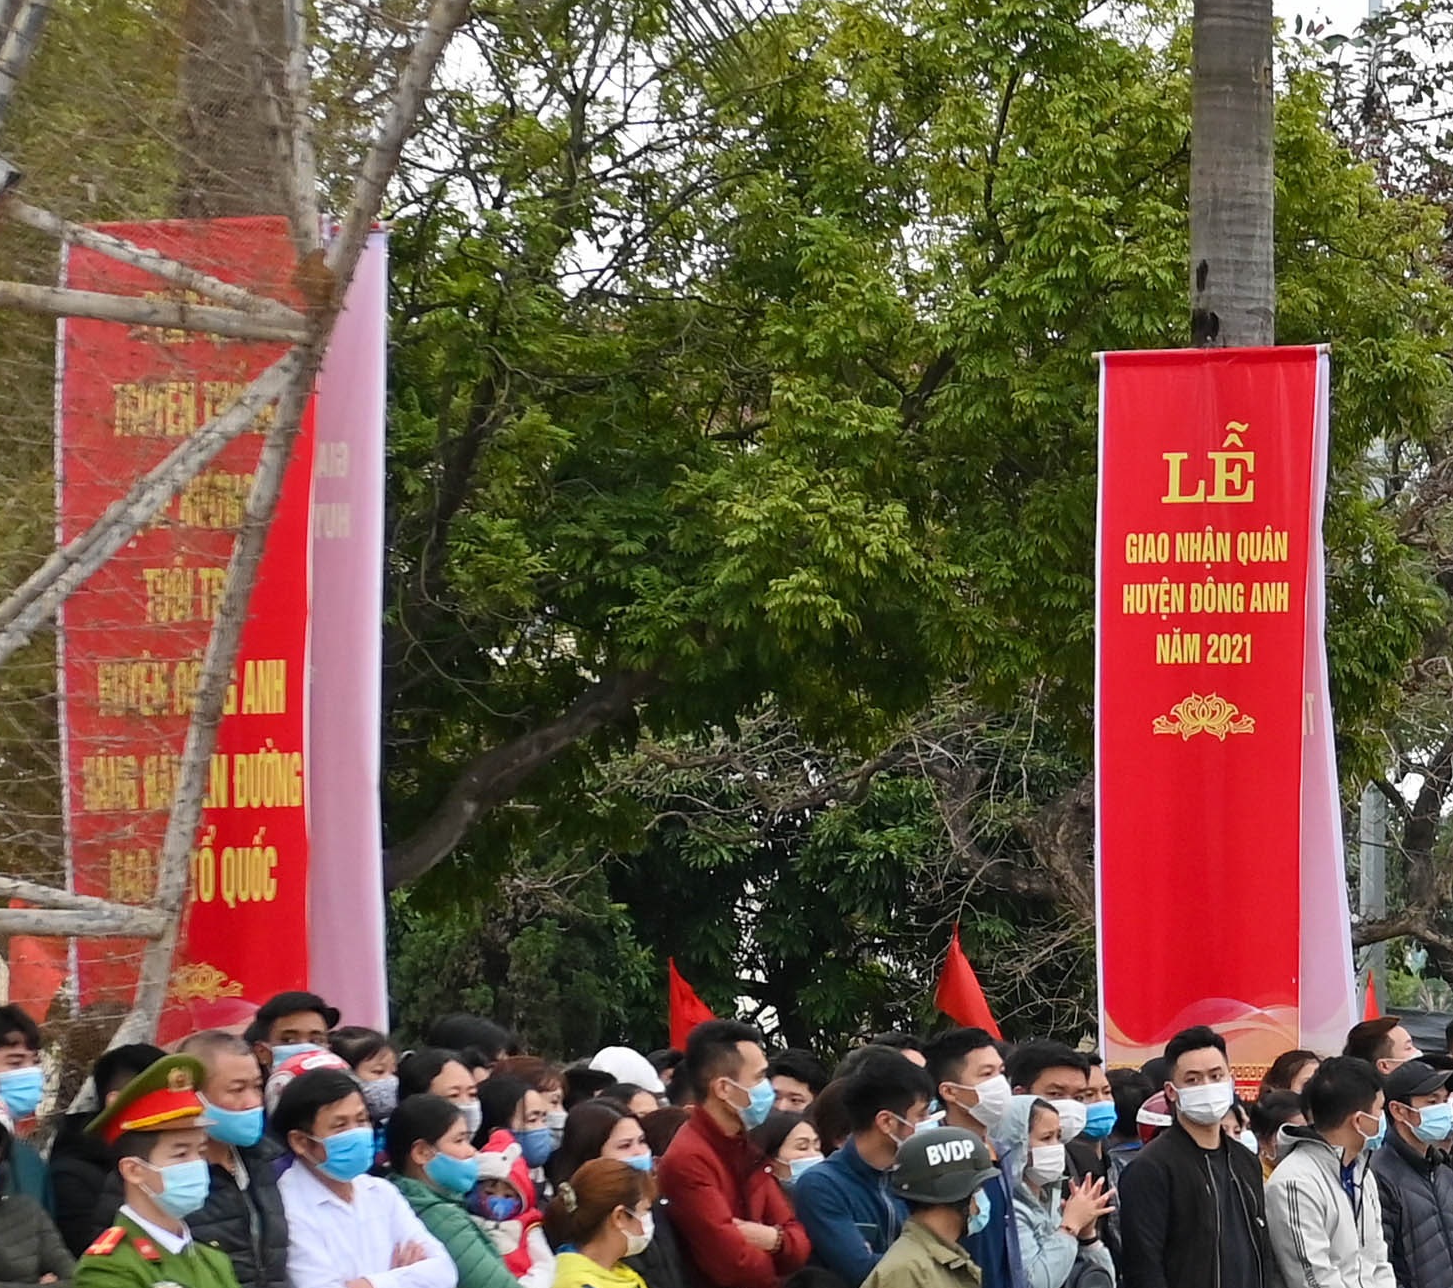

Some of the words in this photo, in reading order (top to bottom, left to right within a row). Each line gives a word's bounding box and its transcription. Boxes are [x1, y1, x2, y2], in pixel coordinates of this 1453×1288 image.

[1161, 420, 1255, 504] LỄ
[1125, 532, 1171, 565] GIAO
[1175, 525, 1231, 569] NHẬN
[1236, 525, 1288, 565] QUÂN
[199, 567, 227, 622] TR
[1122, 576, 1185, 621] HUYỆN
[1189, 576, 1245, 614] ĐÔNG
[1249, 581, 1290, 613] ANH
[1155, 628, 1201, 665] NĂM
[1206, 632, 1253, 665] 2021
[241, 659, 286, 715] ANH
[233, 737, 302, 809] ĐƯỜNG
[220, 825, 278, 909] QUỐC
[925, 1139, 975, 1167] BVDP
